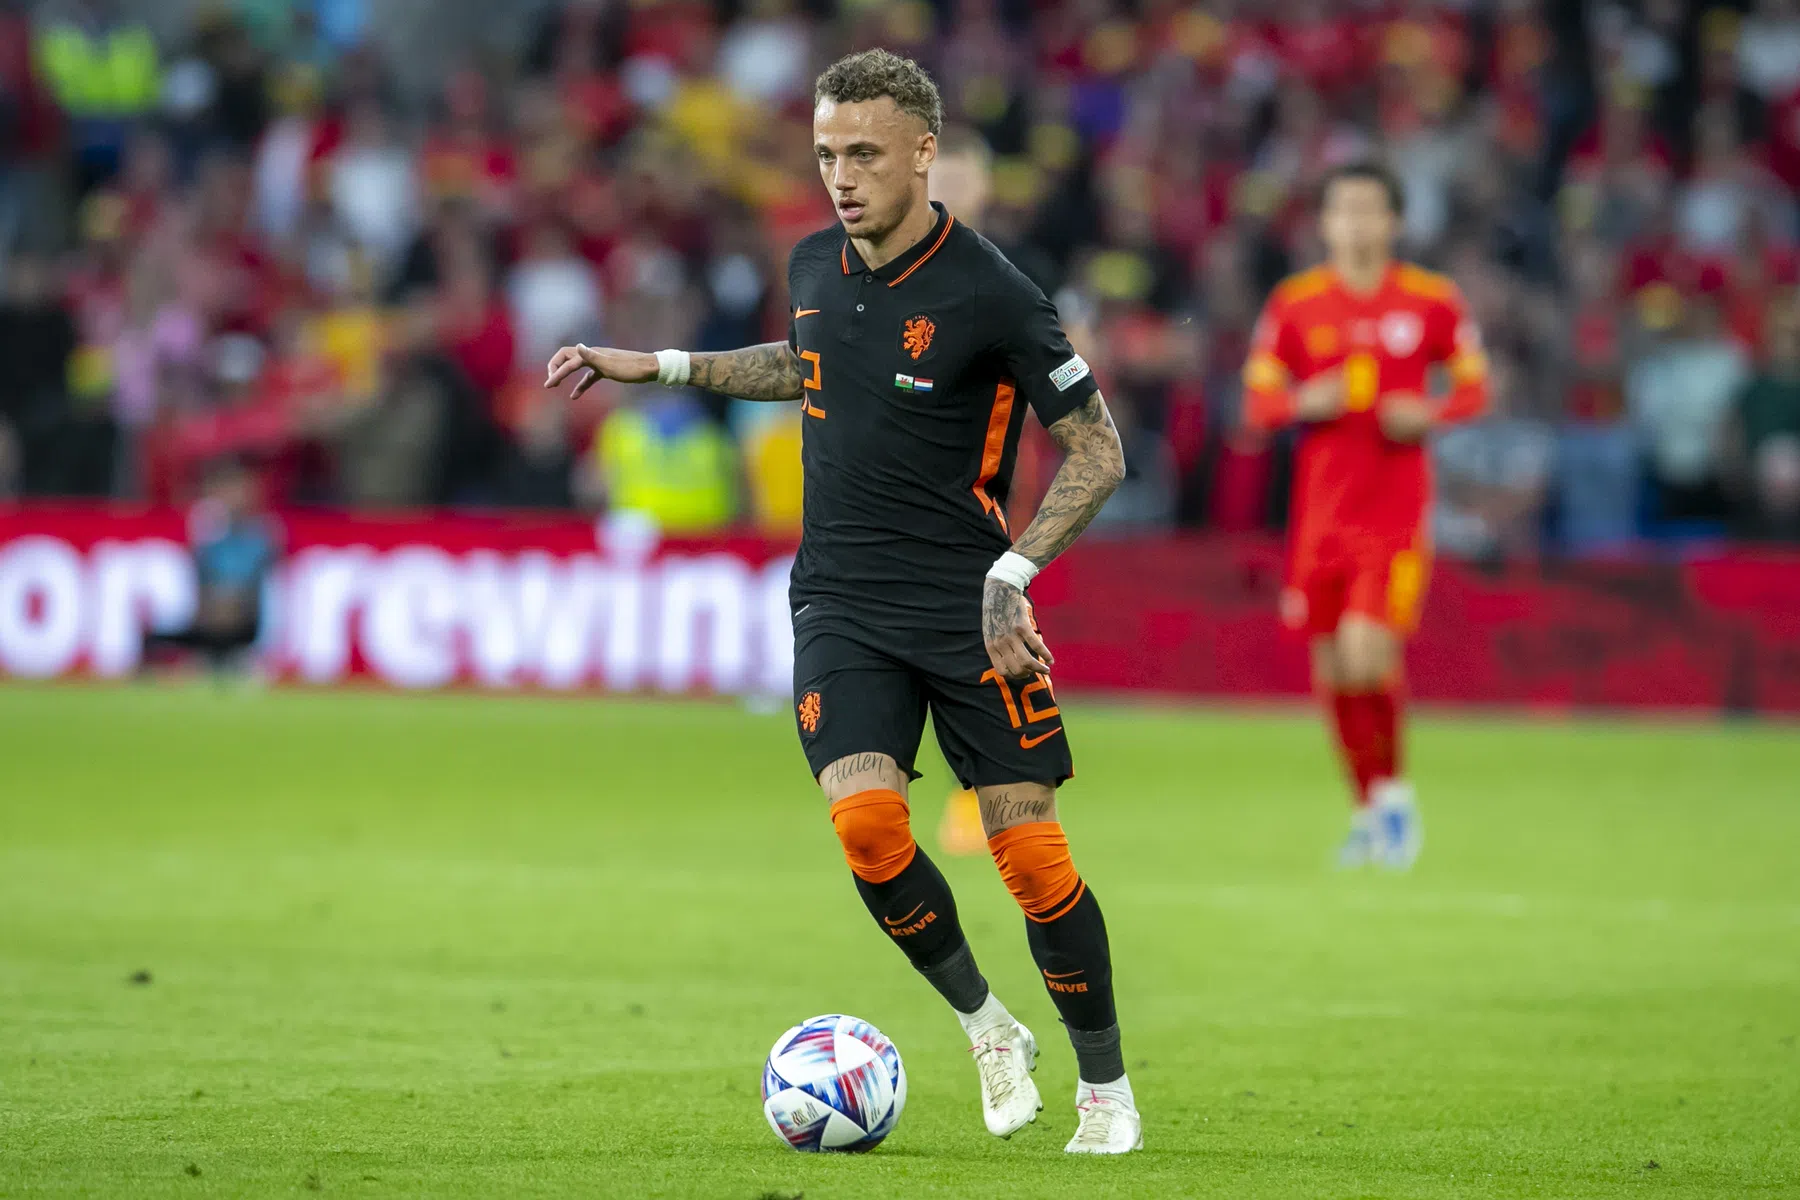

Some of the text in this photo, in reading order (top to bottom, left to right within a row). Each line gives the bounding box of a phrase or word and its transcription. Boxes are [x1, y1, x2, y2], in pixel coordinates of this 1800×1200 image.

[291, 510, 797, 698] rewin
[980, 667, 1060, 729] 12
[890, 911, 938, 936] KNVB
[1046, 979, 1089, 993] KNVB
